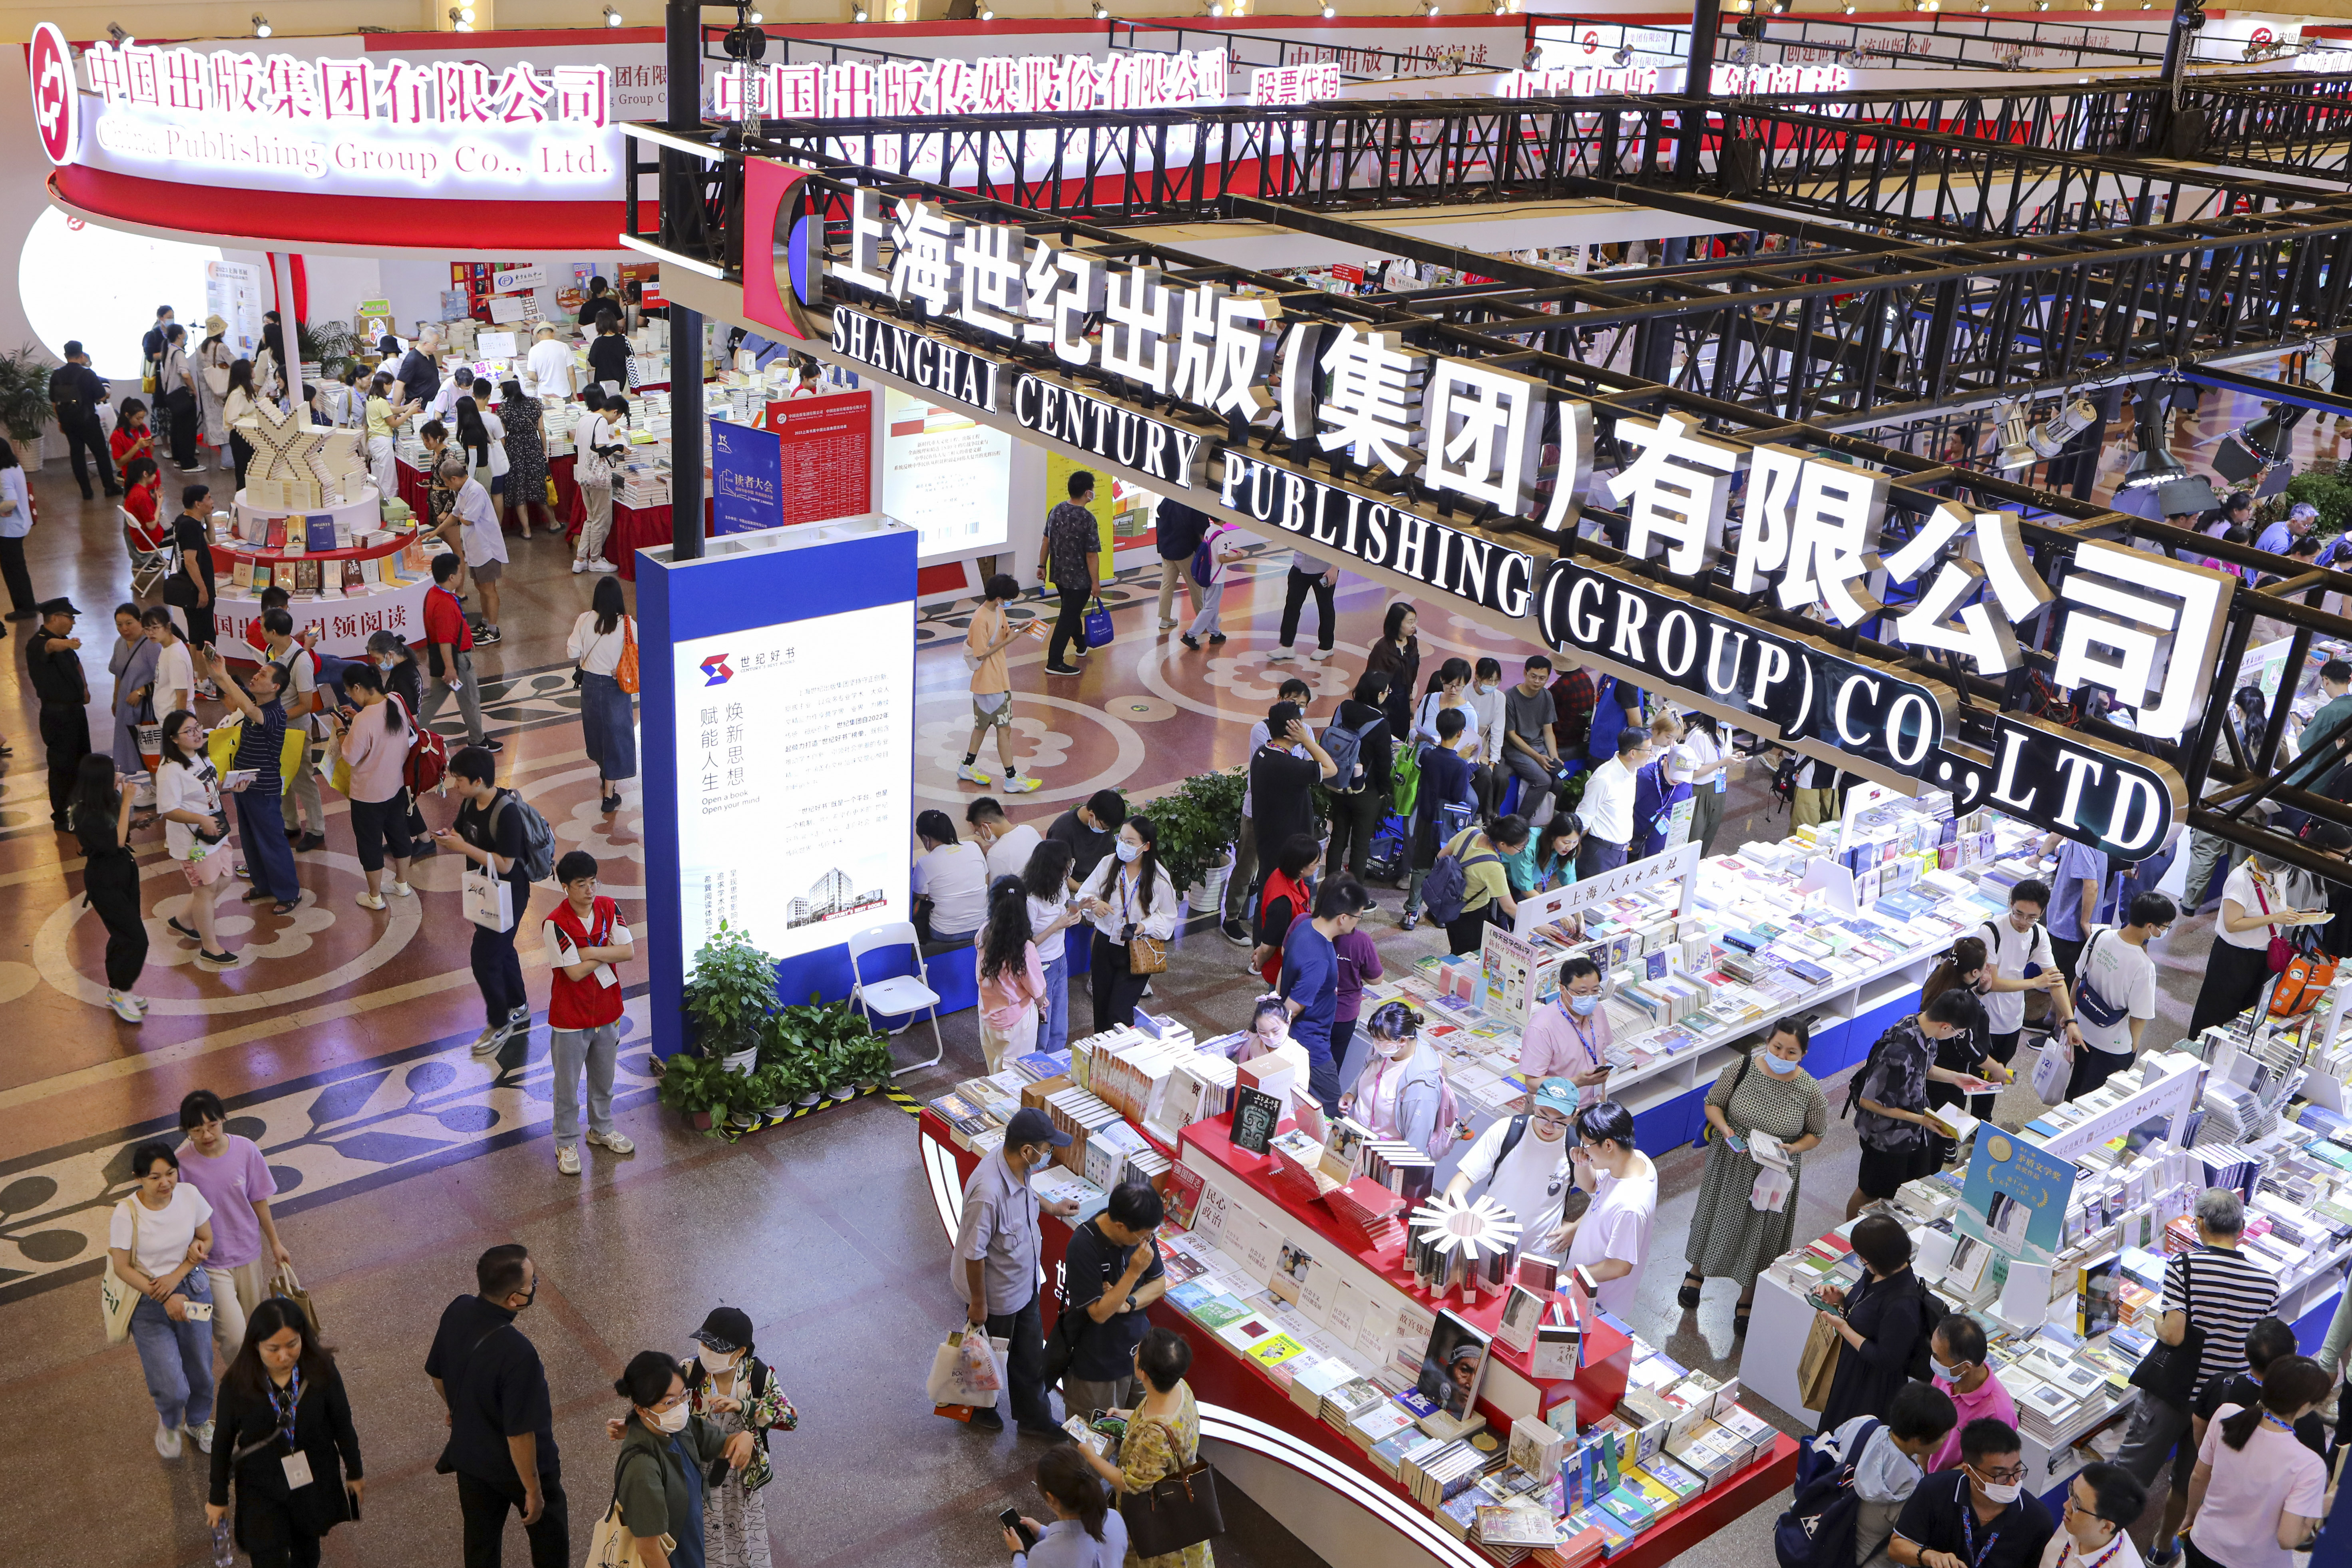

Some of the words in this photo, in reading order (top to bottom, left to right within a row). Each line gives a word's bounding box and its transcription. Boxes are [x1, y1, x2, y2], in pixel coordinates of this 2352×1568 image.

[1290, 45, 1383, 73] 中国出版
[86, 45, 607, 129] 中国出版集团有限公司
[1255, 66, 1339, 105] 股票代码
[166, 130, 320, 175] Publishing
[335, 142, 437, 179] Group
[455, 146, 521, 177] Co.,
[541, 145, 608, 173] Ltd.
[826, 404, 866, 413] 中国出版传媒股份有限公司
[831, 189, 2223, 739] 上海世纪出版（集团）有限公司
[734, 473, 773, 493] 读者大会
[832, 304, 999, 415] SHANGHAI
[1016, 374, 1200, 489] CENTURY
[1220, 451, 1533, 619] PUBLISHING
[1546, 566, 1813, 734] (GROUP)
[740, 647, 795, 668] 世纪好书
[740, 664, 766, 673] CENTURY'S
[837, 712, 889, 728] 世纪集团自2022年
[700, 706, 719, 792] 赋能人生
[726, 702, 744, 786] 焕新思想
[702, 796, 722, 806] Open
[730, 790, 748, 798] book
[702, 805, 722, 815] Open
[724, 802, 740, 812] your
[742, 796, 760, 804] mind
[1569, 856, 1677, 907] 上海人民出版社
[854, 905, 867, 915] BEST
[868, 901, 885, 912] BOOKS
[1192, 1081, 1201, 1097] 贺
[1254, 1094, 1279, 1113] 上下五千年
[1173, 1164, 1202, 1188] 强国图志
[2015, 1163, 2040, 1181] 获奖作品
[2017, 1154, 2061, 1182] 茅盾文学奖
[1206, 1188, 1226, 1211] 民心
[1201, 1206, 1222, 1228] 政治
[1182, 1236, 1207, 1252] 政治
[1250, 1247, 1266, 1262] 社会主义
[1303, 1286, 1320, 1302] 社会主义
[1333, 1306, 1350, 1323] 社会主义
[1363, 1326, 1380, 1343] 社会主义
[1399, 1313, 1432, 1338] 故宫建筑
[1681, 1453, 1693, 1462] La
[1697, 1451, 1715, 1465] Place
